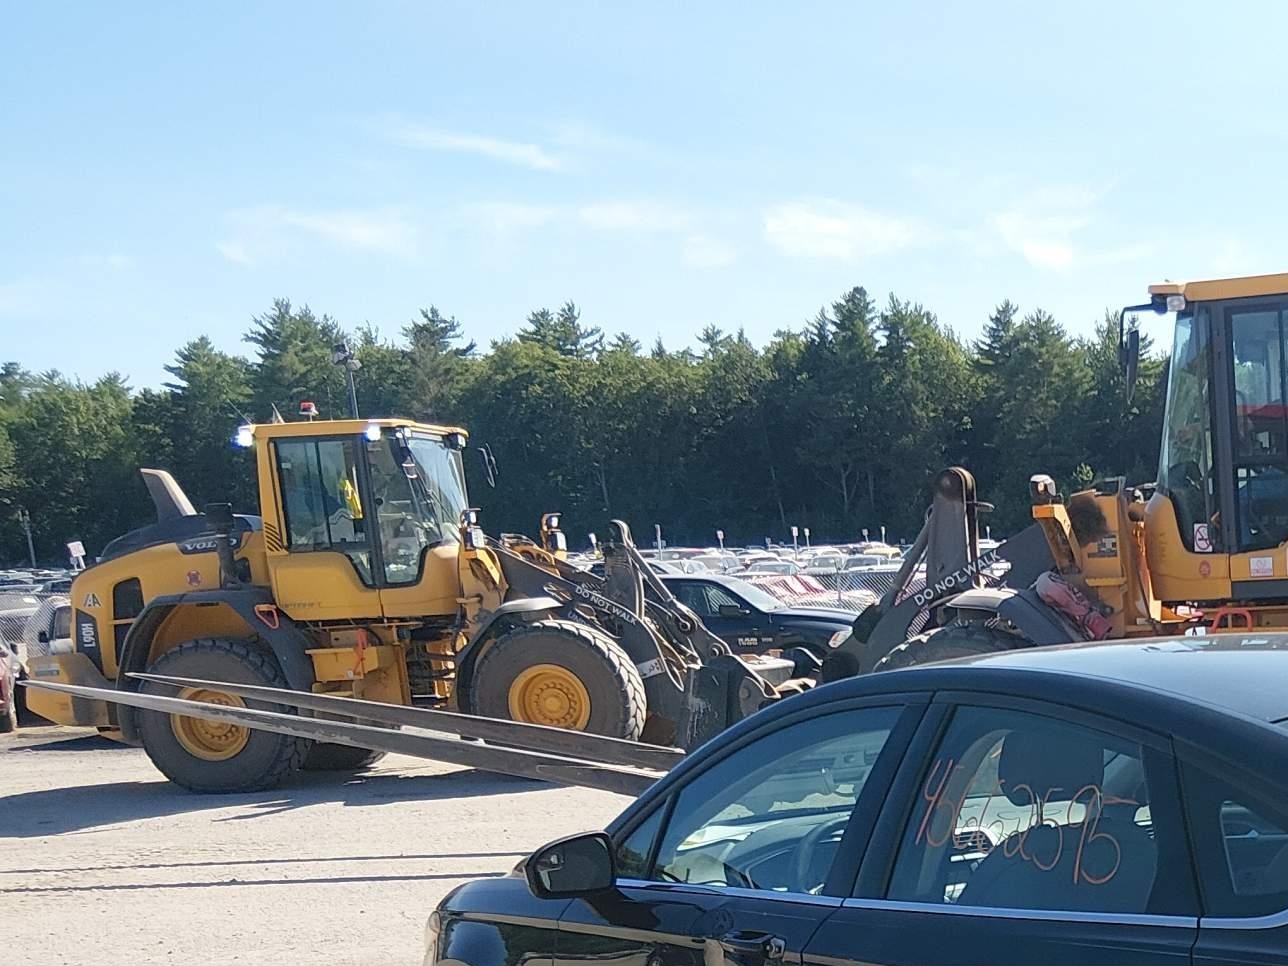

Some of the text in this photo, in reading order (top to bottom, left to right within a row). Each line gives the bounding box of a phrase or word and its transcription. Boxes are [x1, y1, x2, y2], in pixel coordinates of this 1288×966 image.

[914, 549, 1000, 606] DO NOT WALK
[575, 586, 637, 626] DO NOT WALK
[81, 623, 97, 648] L90H
